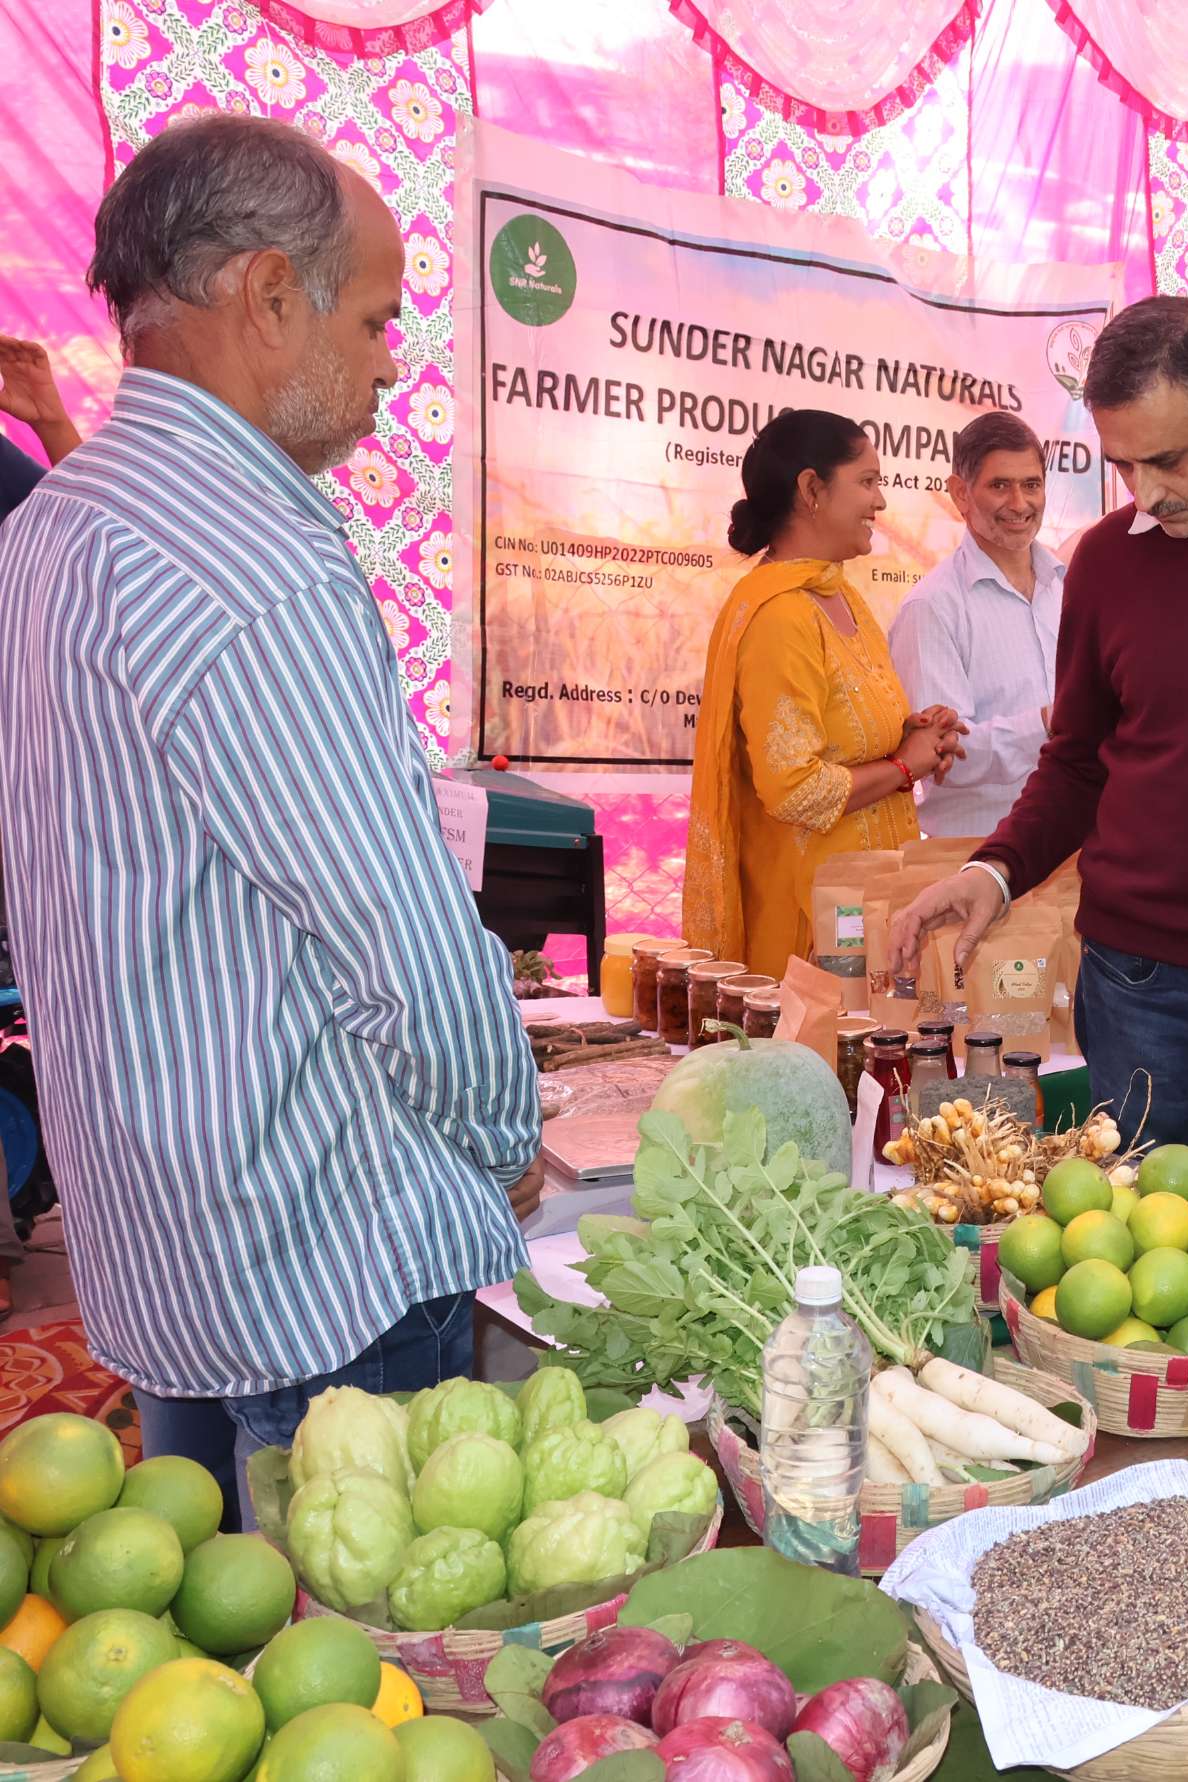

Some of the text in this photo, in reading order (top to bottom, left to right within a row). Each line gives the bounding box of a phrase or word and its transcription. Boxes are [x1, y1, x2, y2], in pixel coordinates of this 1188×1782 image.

[609, 311, 1023, 412] SUNDER NAGAR NATURALS
[491, 362, 645, 423] FARMER
[656, 387, 795, 438] PRODU
[853, 419, 959, 464] OMPA
[665, 441, 743, 468] (Register
[892, 472, 920, 490] Act
[924, 476, 949, 493] 201
[494, 535, 516, 550] CIN
[540, 540, 713, 568] U01409HP2022PTC009605
[495, 562, 519, 577] GST
[501, 680, 554, 703] Regd.
[558, 683, 622, 704] Address
